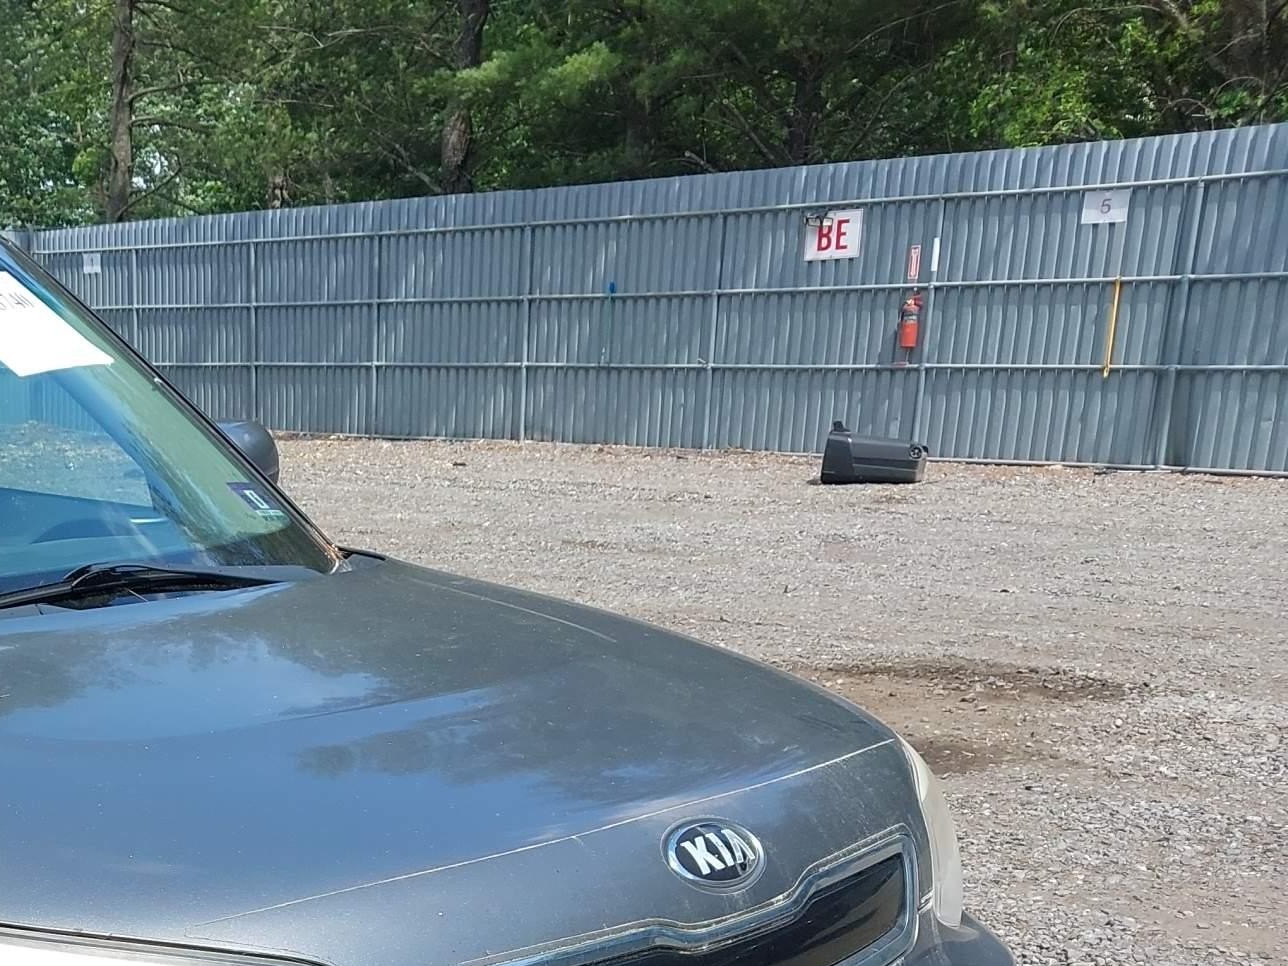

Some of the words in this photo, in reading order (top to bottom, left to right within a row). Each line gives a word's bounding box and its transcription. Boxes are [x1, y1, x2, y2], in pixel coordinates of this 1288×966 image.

[1100, 198, 1113, 215] 5
[816, 218, 851, 252] BE
[679, 829, 756, 876] KIA
